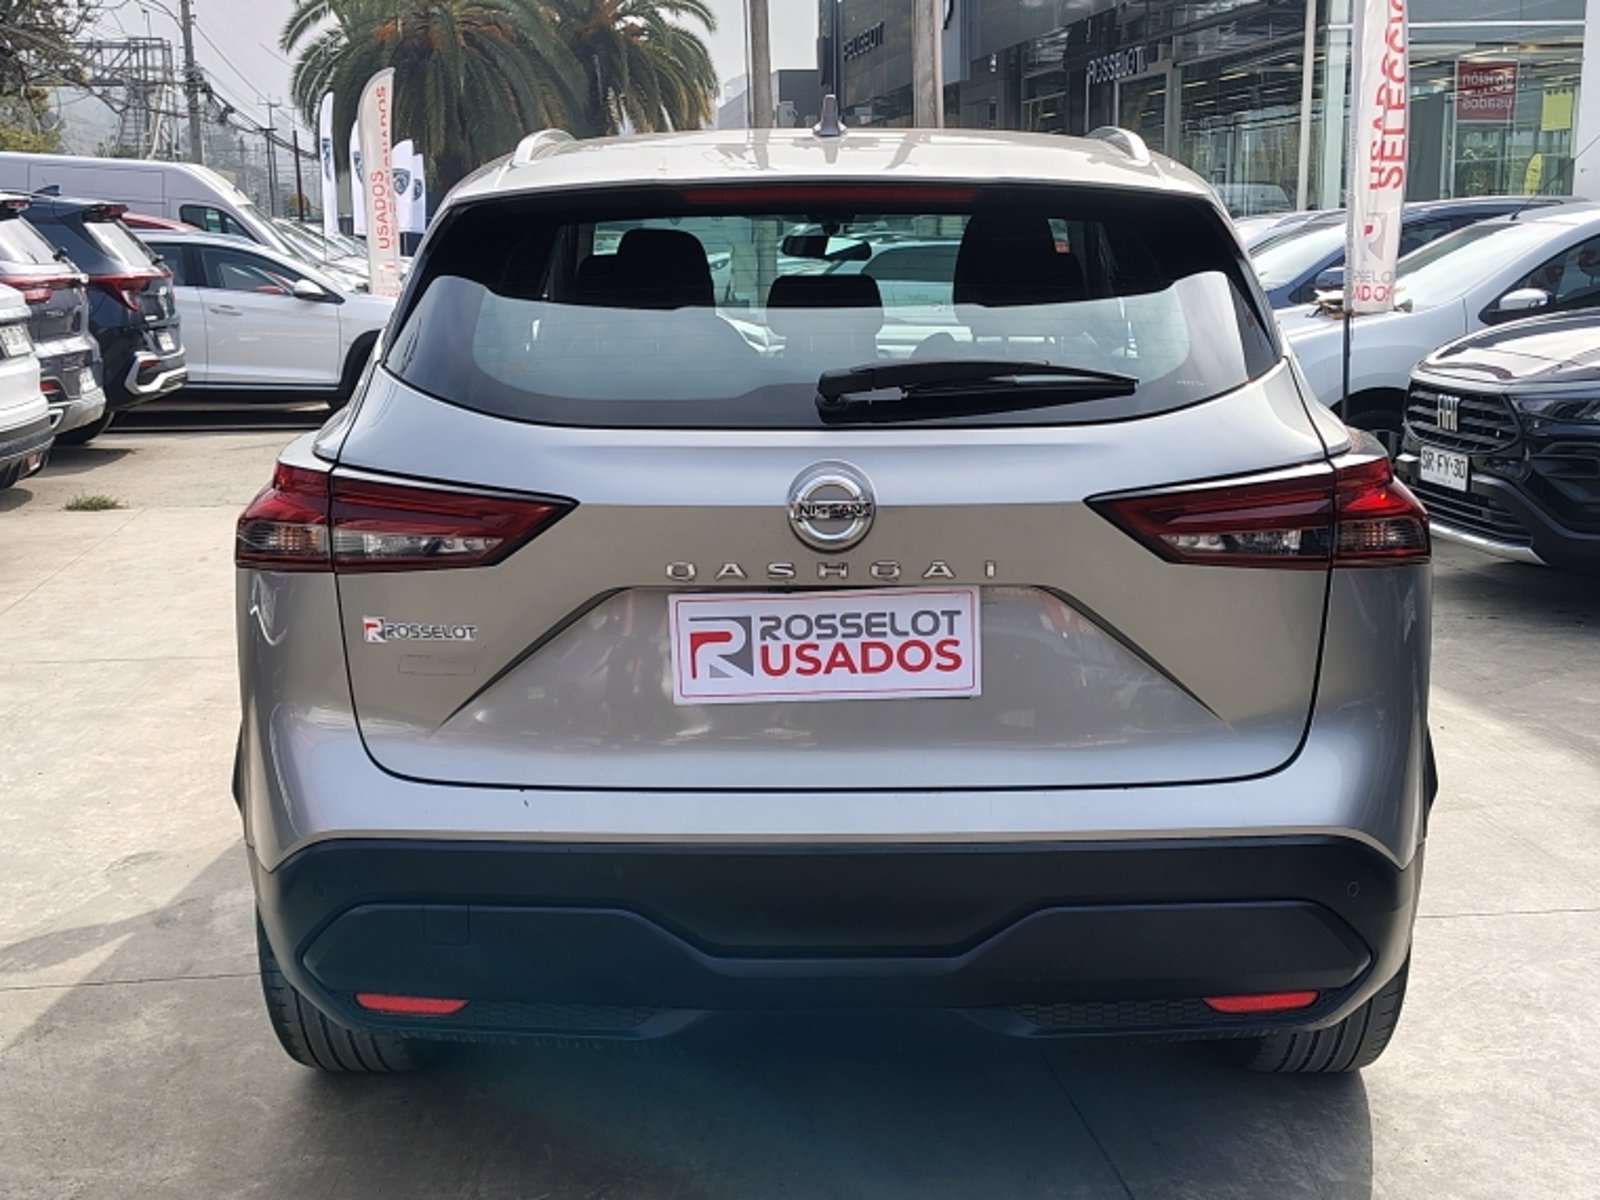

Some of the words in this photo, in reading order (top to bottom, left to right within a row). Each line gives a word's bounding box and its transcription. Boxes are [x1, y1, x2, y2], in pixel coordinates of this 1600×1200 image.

[371, 170, 390, 250] USADOS
[799, 503, 865, 518] NISSAN
[665, 560, 998, 583] QASHQAI
[384, 623, 477, 640] ROSSELOT
[759, 609, 963, 642] ROSSELOT
[759, 639, 963, 677] USADOS
